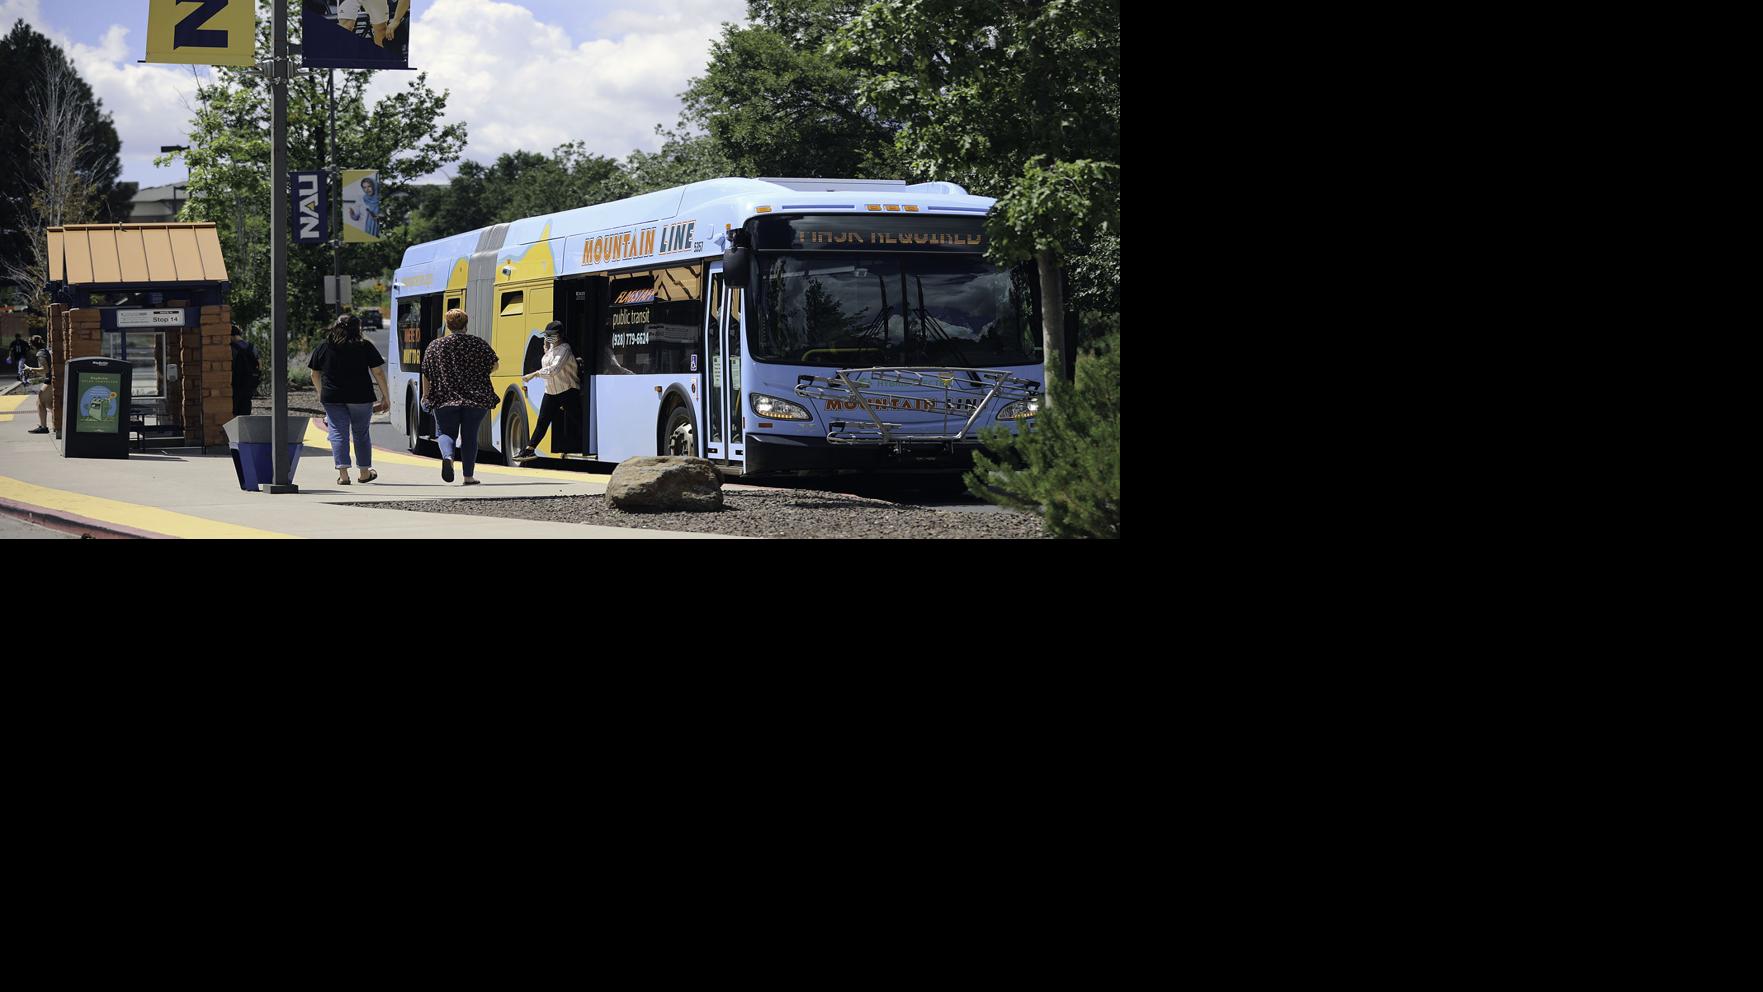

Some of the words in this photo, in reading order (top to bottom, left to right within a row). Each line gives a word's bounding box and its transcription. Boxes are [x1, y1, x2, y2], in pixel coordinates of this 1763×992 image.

[298, 175, 320, 239] NAU
[581, 228, 656, 266] MOUNTAIN
[659, 219, 696, 255] LINE
[612, 307, 631, 330] public
[631, 306, 650, 326] transit
[612, 332, 626, 349] (928)
[626, 332, 650, 347] 779-6624
